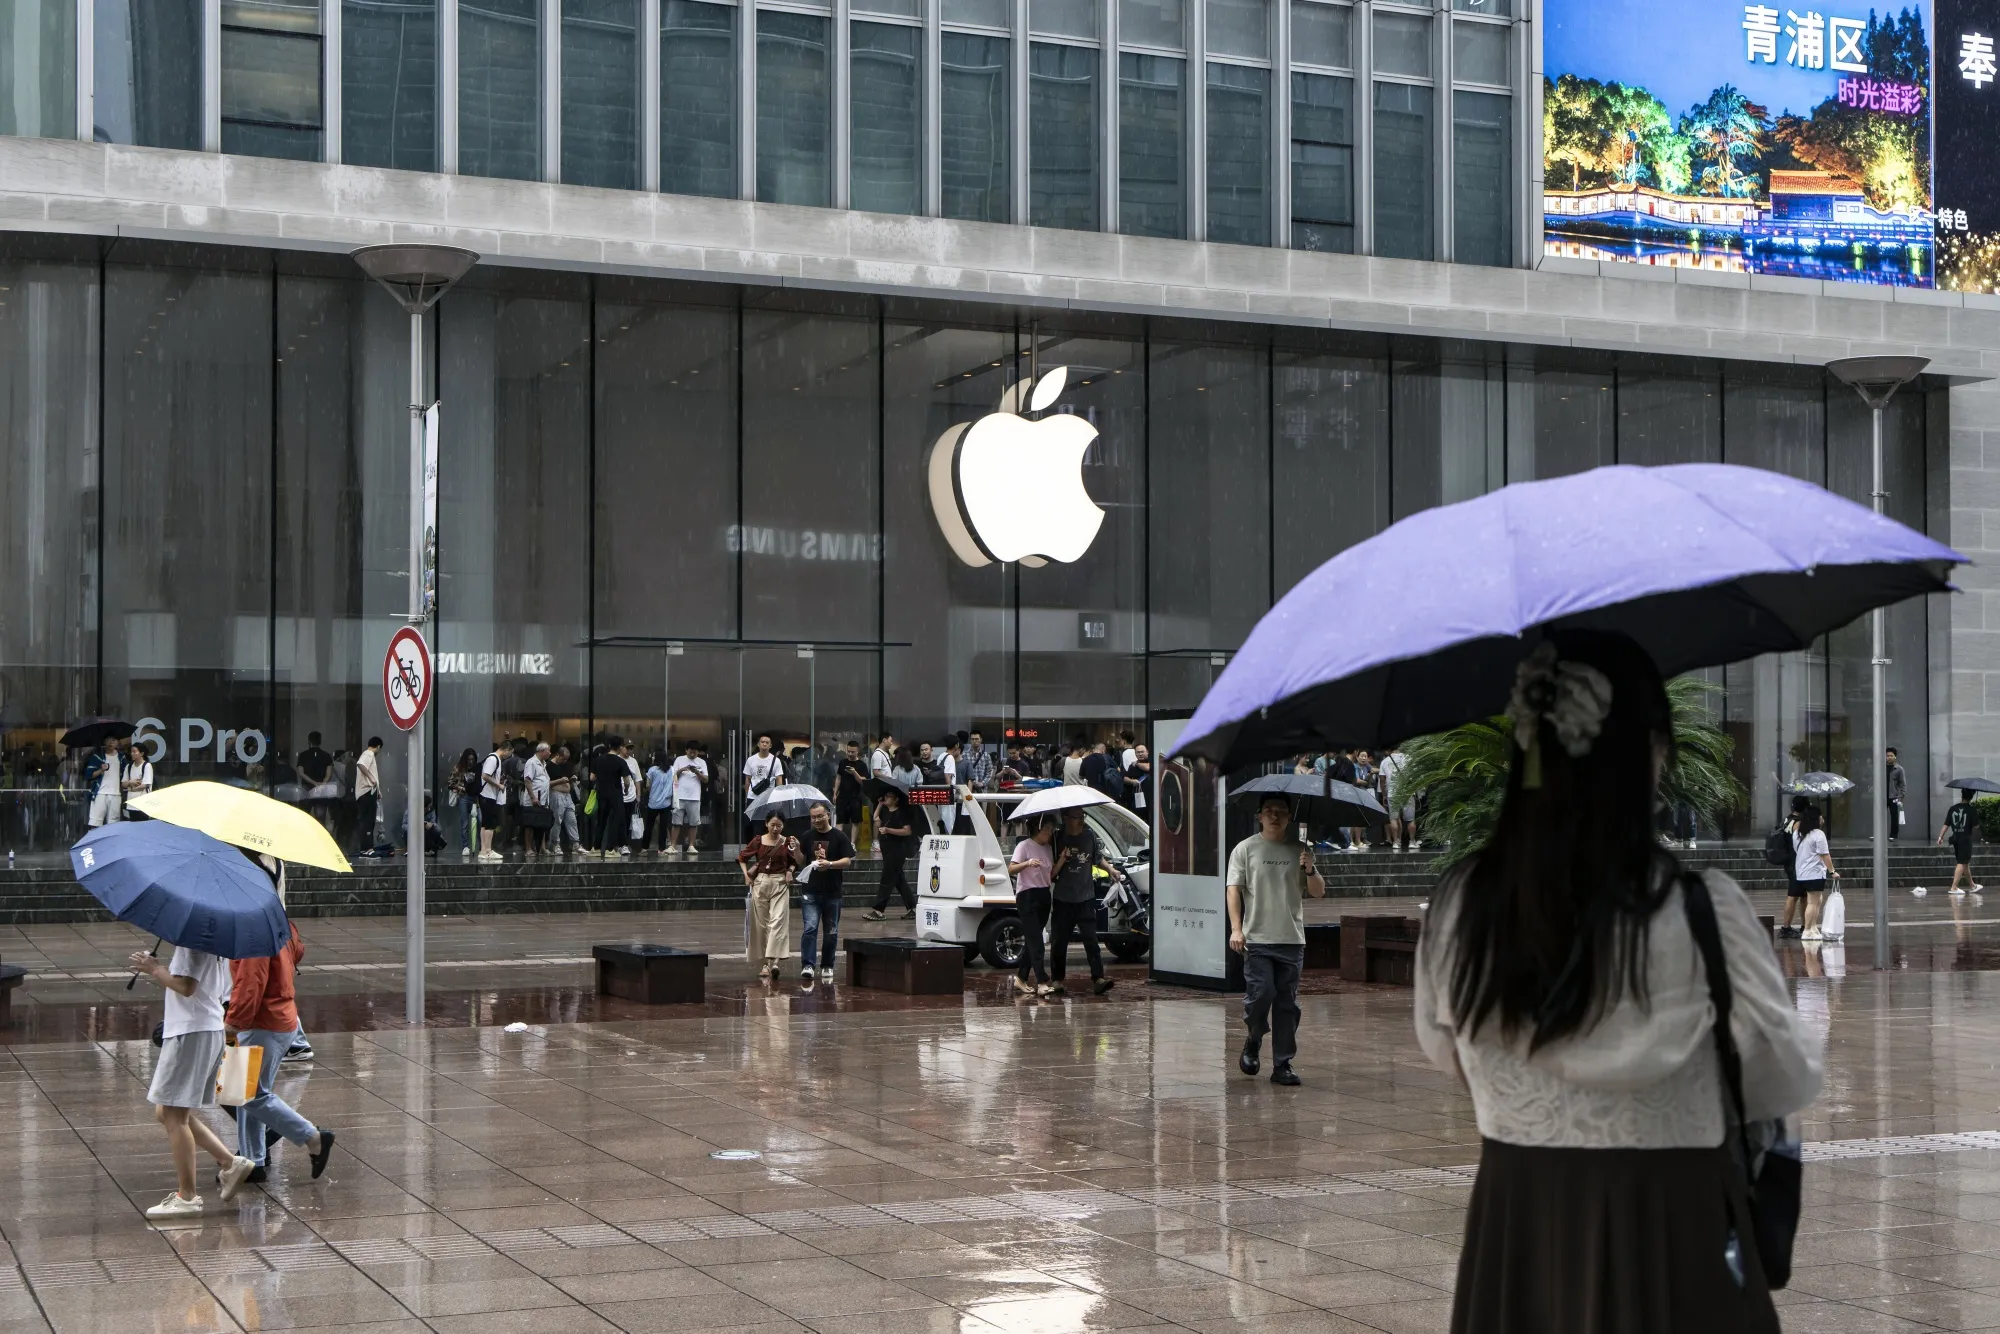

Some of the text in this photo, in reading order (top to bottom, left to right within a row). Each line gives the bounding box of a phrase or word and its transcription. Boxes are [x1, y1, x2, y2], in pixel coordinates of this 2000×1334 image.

[1742, 4, 1868, 73] 青浦区
[1958, 32, 1998, 89] 奉
[1838, 78, 1921, 114] 时光溢彩
[180, 717, 267, 763] Pro
[926, 911, 939, 926] 警察
